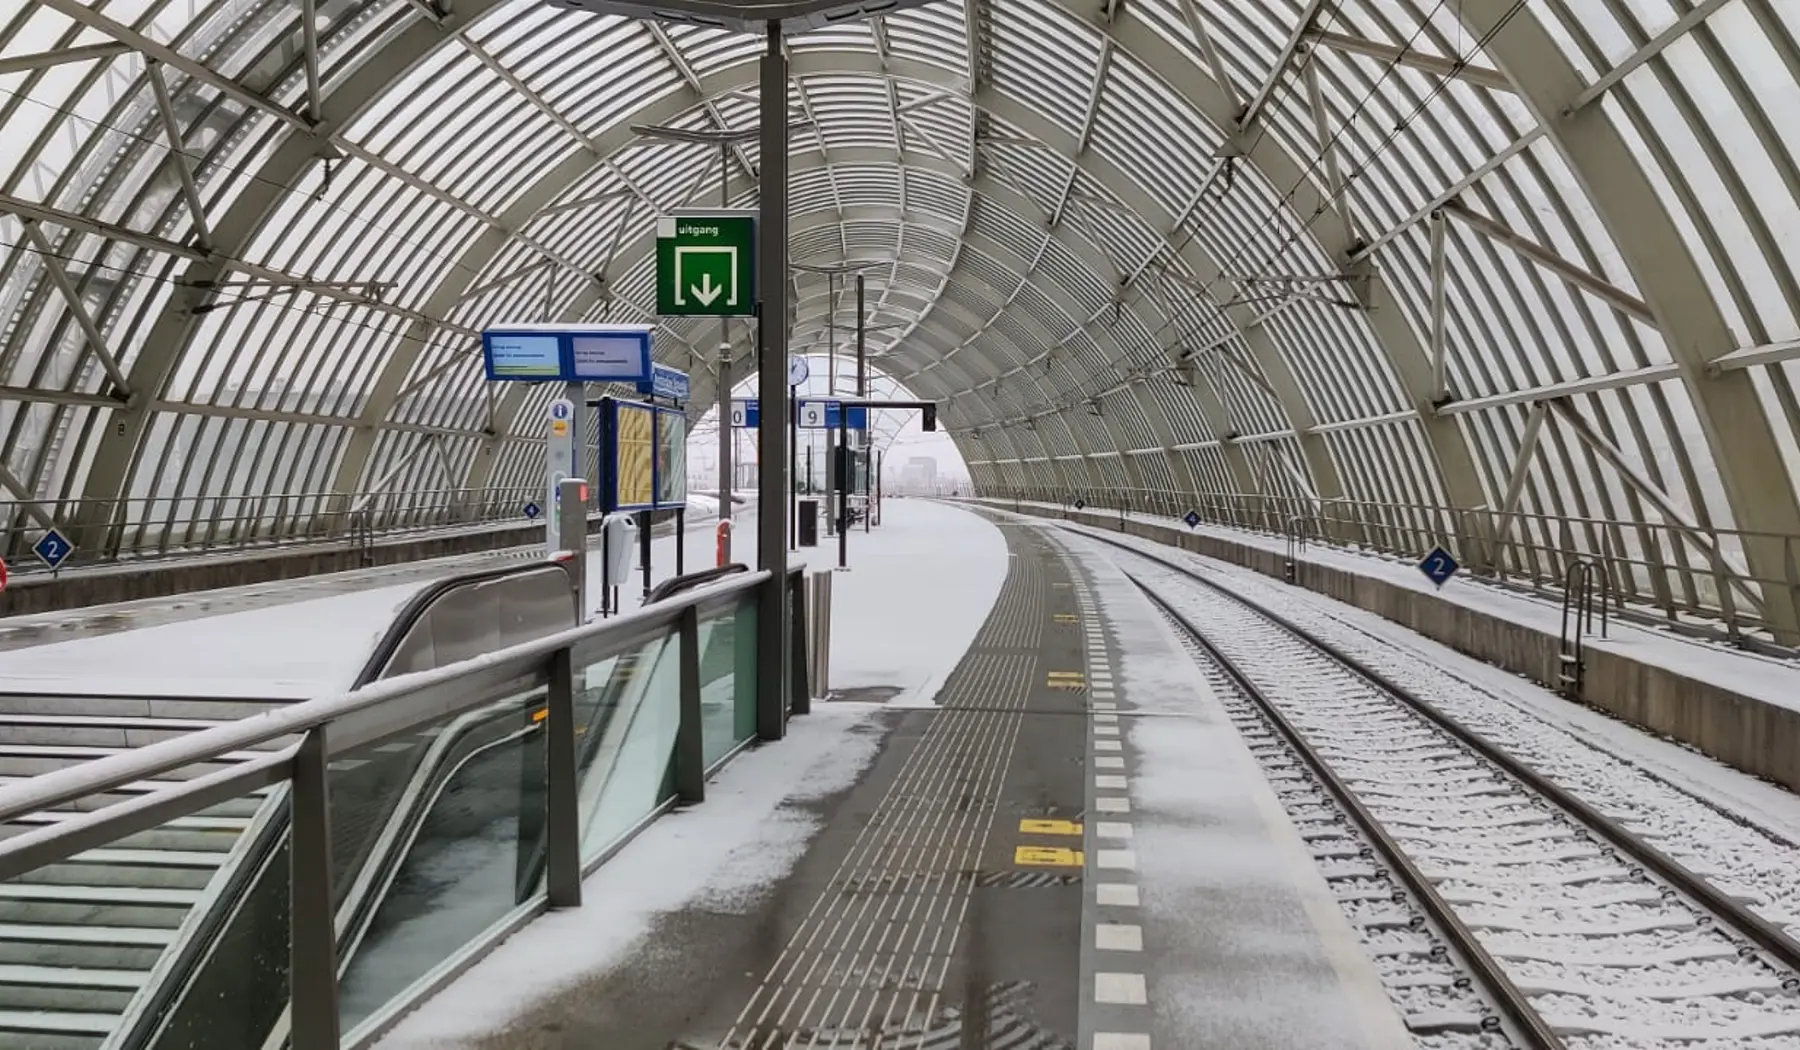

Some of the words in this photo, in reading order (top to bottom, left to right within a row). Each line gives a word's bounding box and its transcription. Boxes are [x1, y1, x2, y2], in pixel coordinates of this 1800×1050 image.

[678, 223, 719, 237] uitgang
[807, 410, 818, 424] 9
[47, 540, 60, 558] 2
[1433, 557, 1446, 575] 2
